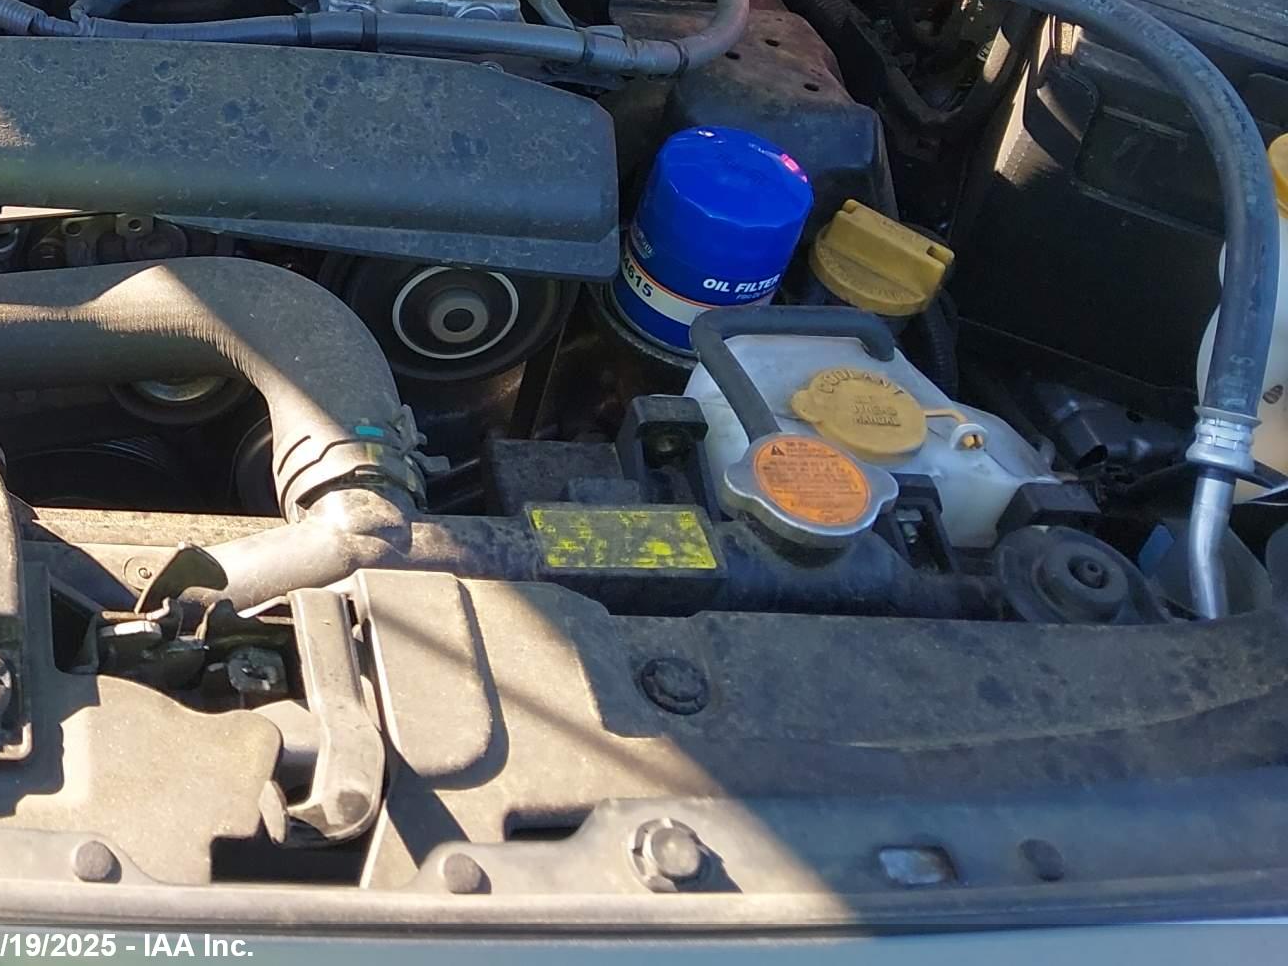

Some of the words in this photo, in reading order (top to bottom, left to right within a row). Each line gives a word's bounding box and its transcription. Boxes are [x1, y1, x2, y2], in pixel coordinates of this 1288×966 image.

[703, 278, 730, 293] OIL
[734, 273, 781, 294] FILTER
[818, 369, 906, 395] COOLANT
